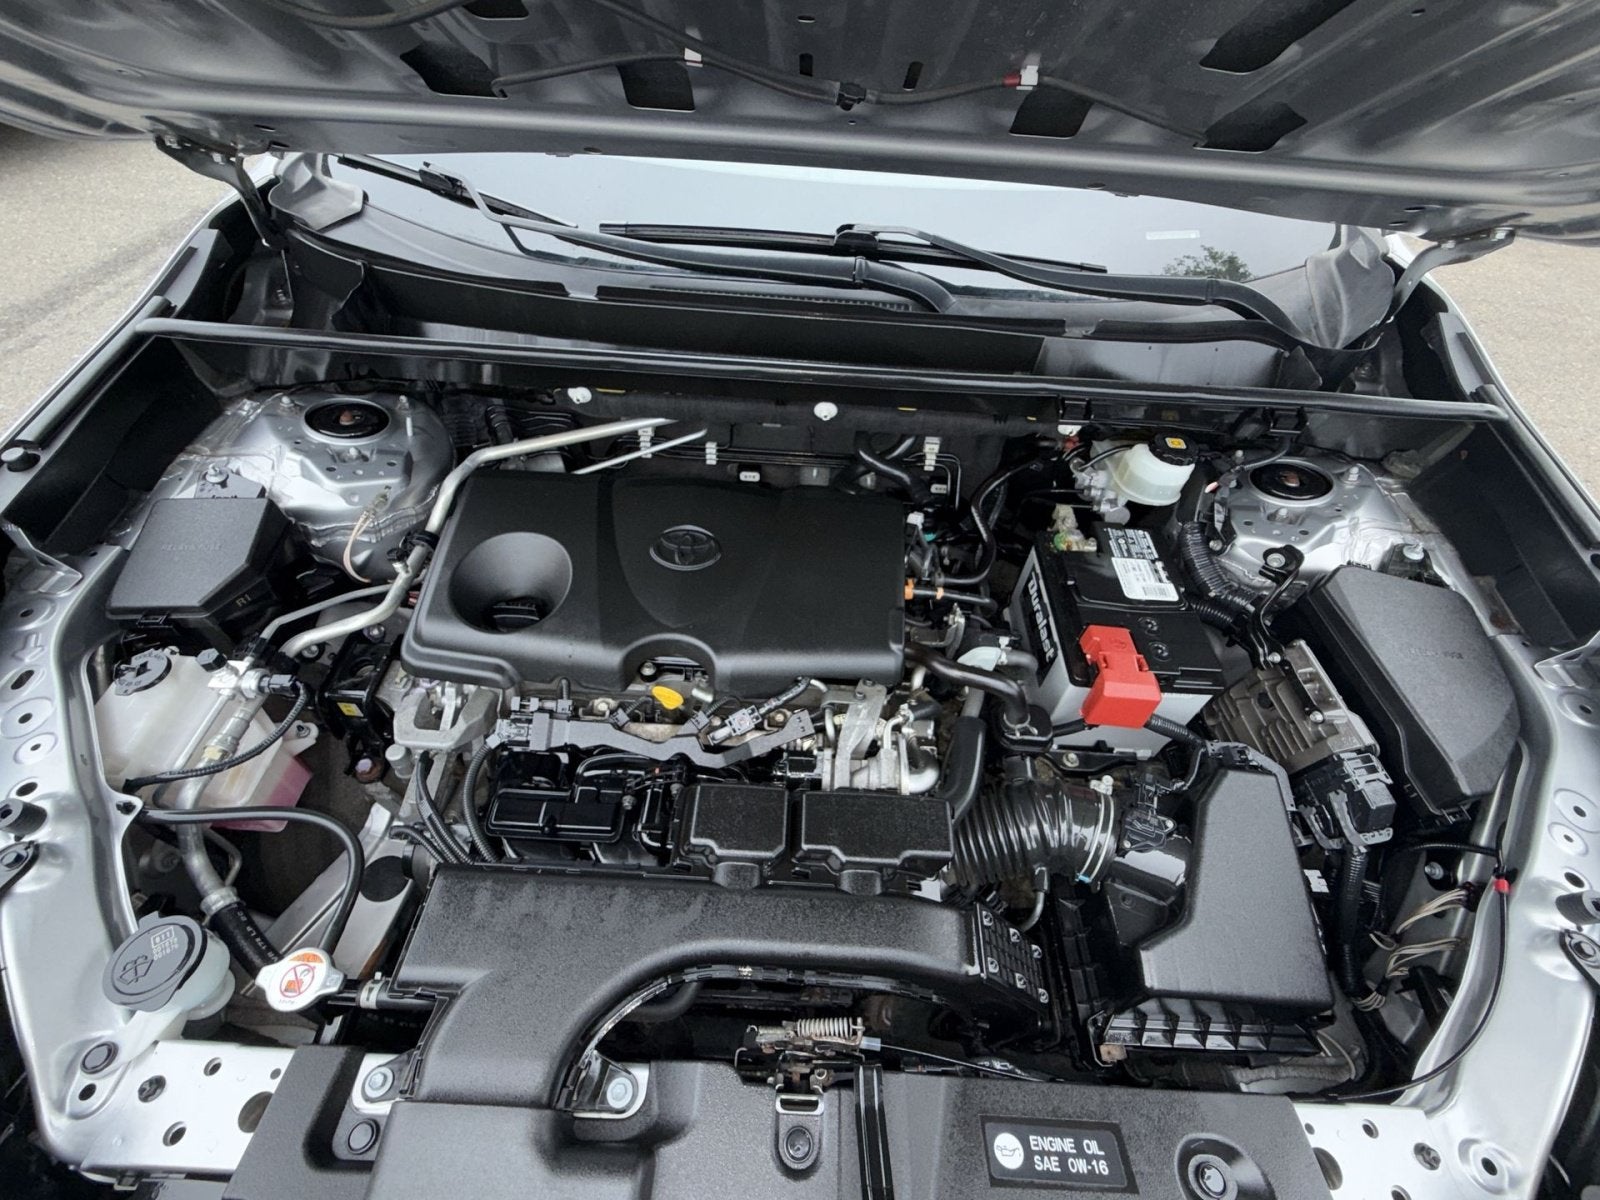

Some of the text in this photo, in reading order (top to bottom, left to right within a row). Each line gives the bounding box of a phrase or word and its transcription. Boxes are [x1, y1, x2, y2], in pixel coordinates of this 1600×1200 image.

[1028, 571, 1055, 663] Duralast
[1029, 1135, 1105, 1155] ENGINE OIL
[1034, 1155, 1109, 1175] SAE 0W-16
